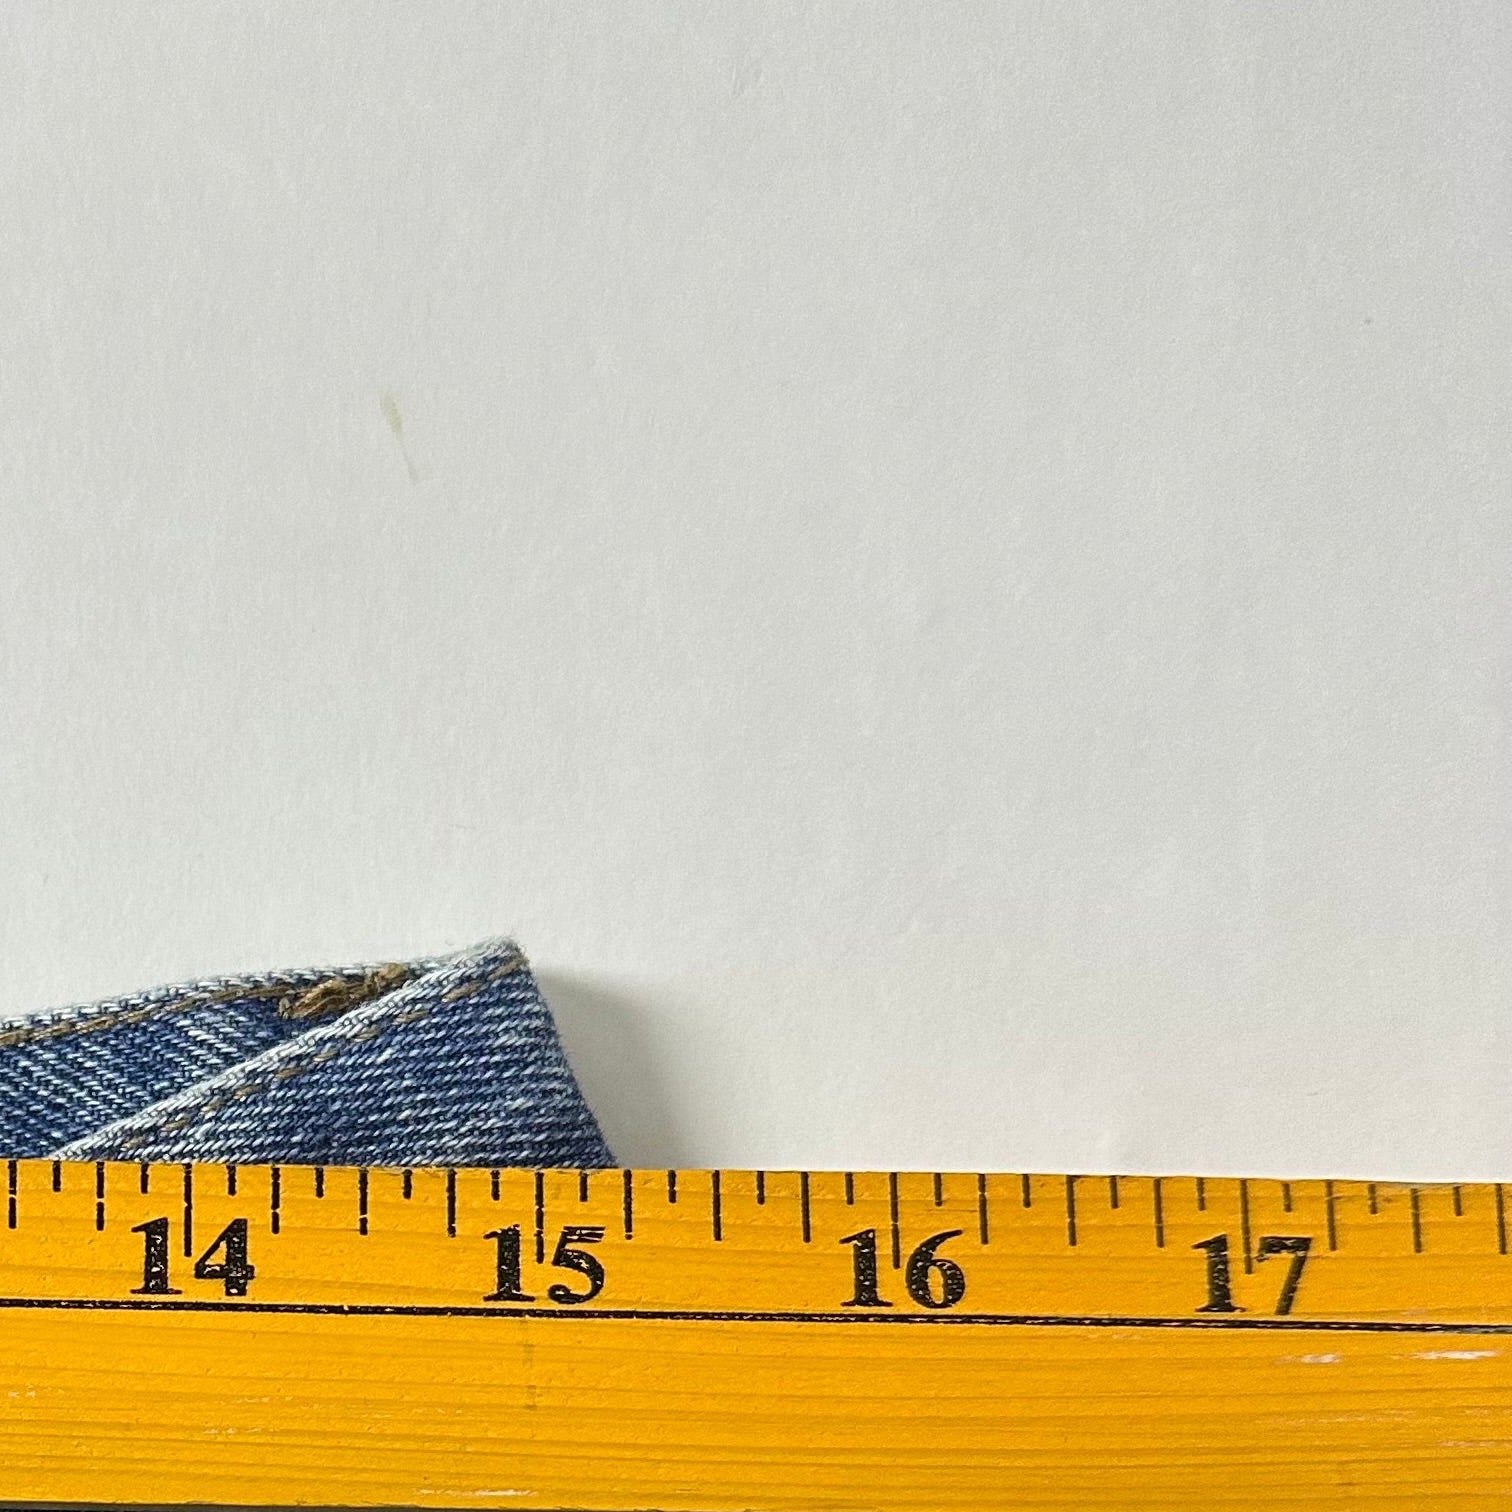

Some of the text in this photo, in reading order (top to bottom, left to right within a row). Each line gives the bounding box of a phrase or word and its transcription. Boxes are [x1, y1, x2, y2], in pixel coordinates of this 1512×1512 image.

[130, 1217, 256, 1297] 14
[483, 1223, 606, 1305] 15
[839, 1228, 966, 1310] 16
[1192, 1234, 1313, 1316] 17
